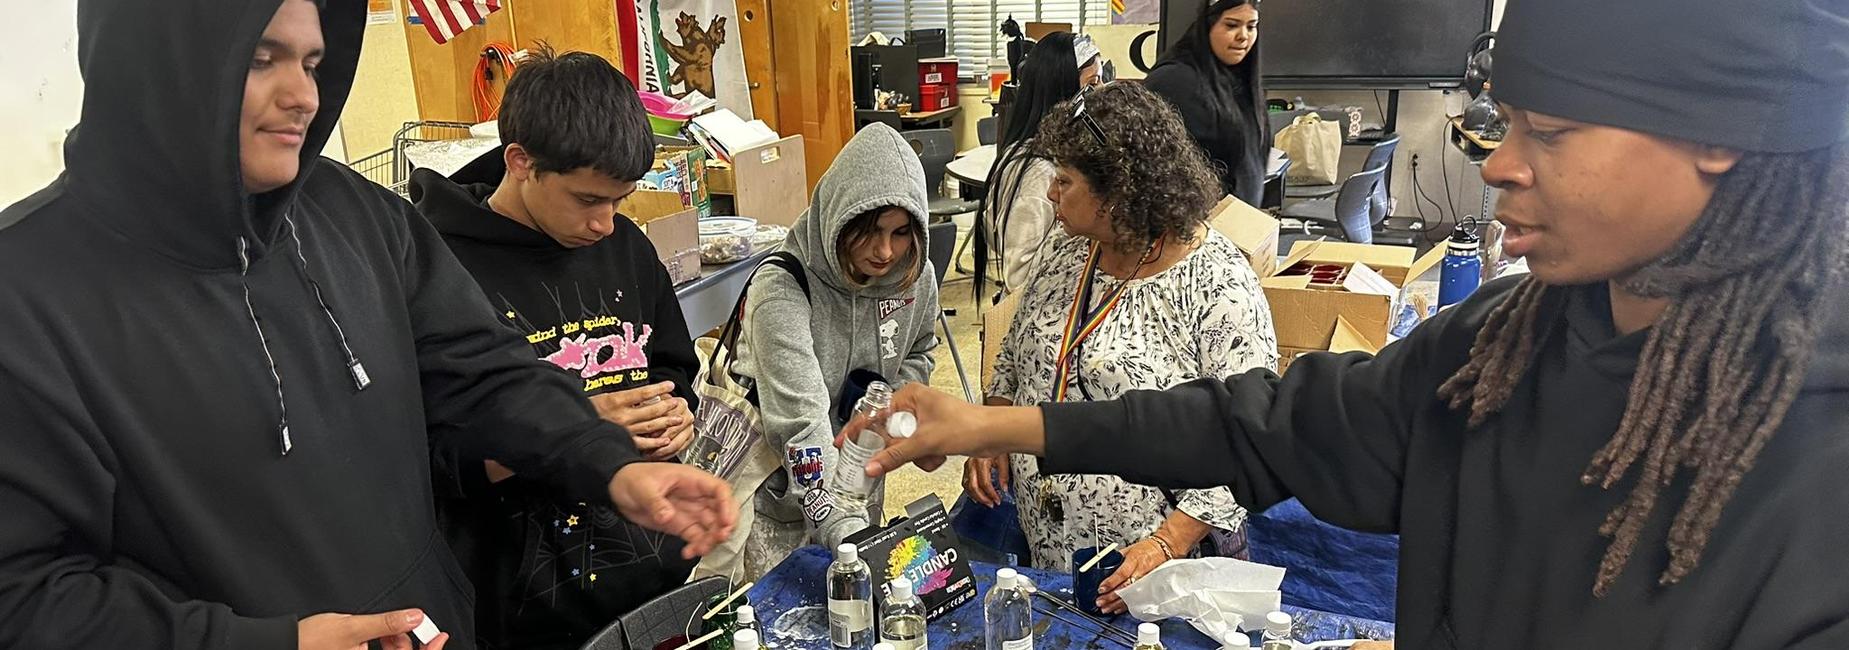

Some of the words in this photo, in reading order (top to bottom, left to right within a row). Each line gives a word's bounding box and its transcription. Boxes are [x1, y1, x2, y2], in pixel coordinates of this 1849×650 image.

[635, 0, 660, 93] ALIFORNIA
[562, 322, 580, 334] the
[630, 370, 648, 381] the
[908, 548, 958, 582] CANDLE
